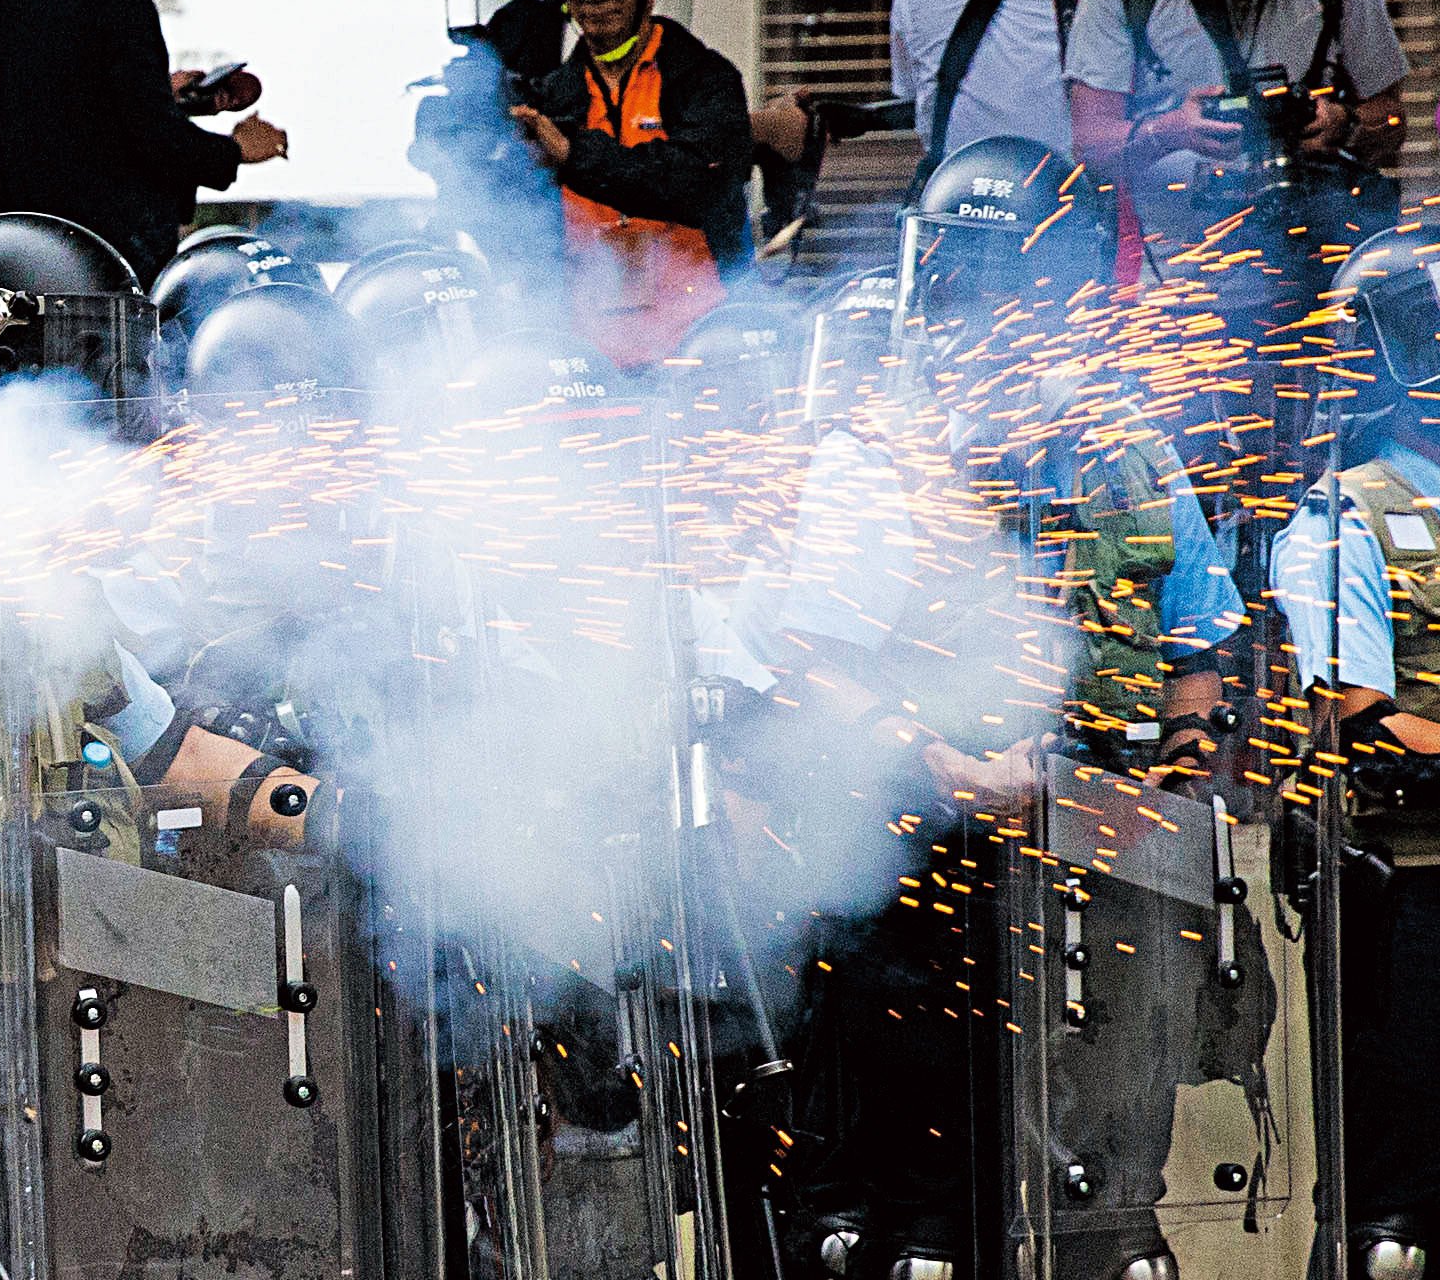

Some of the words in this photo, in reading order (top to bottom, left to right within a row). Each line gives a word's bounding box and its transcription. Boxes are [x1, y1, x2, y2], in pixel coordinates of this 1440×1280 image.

[972, 177, 1014, 198] 警察
[959, 203, 1017, 221] Police
[247, 254, 292, 274] Police
[424, 287, 478, 305] Police
[548, 380, 606, 399] Police
